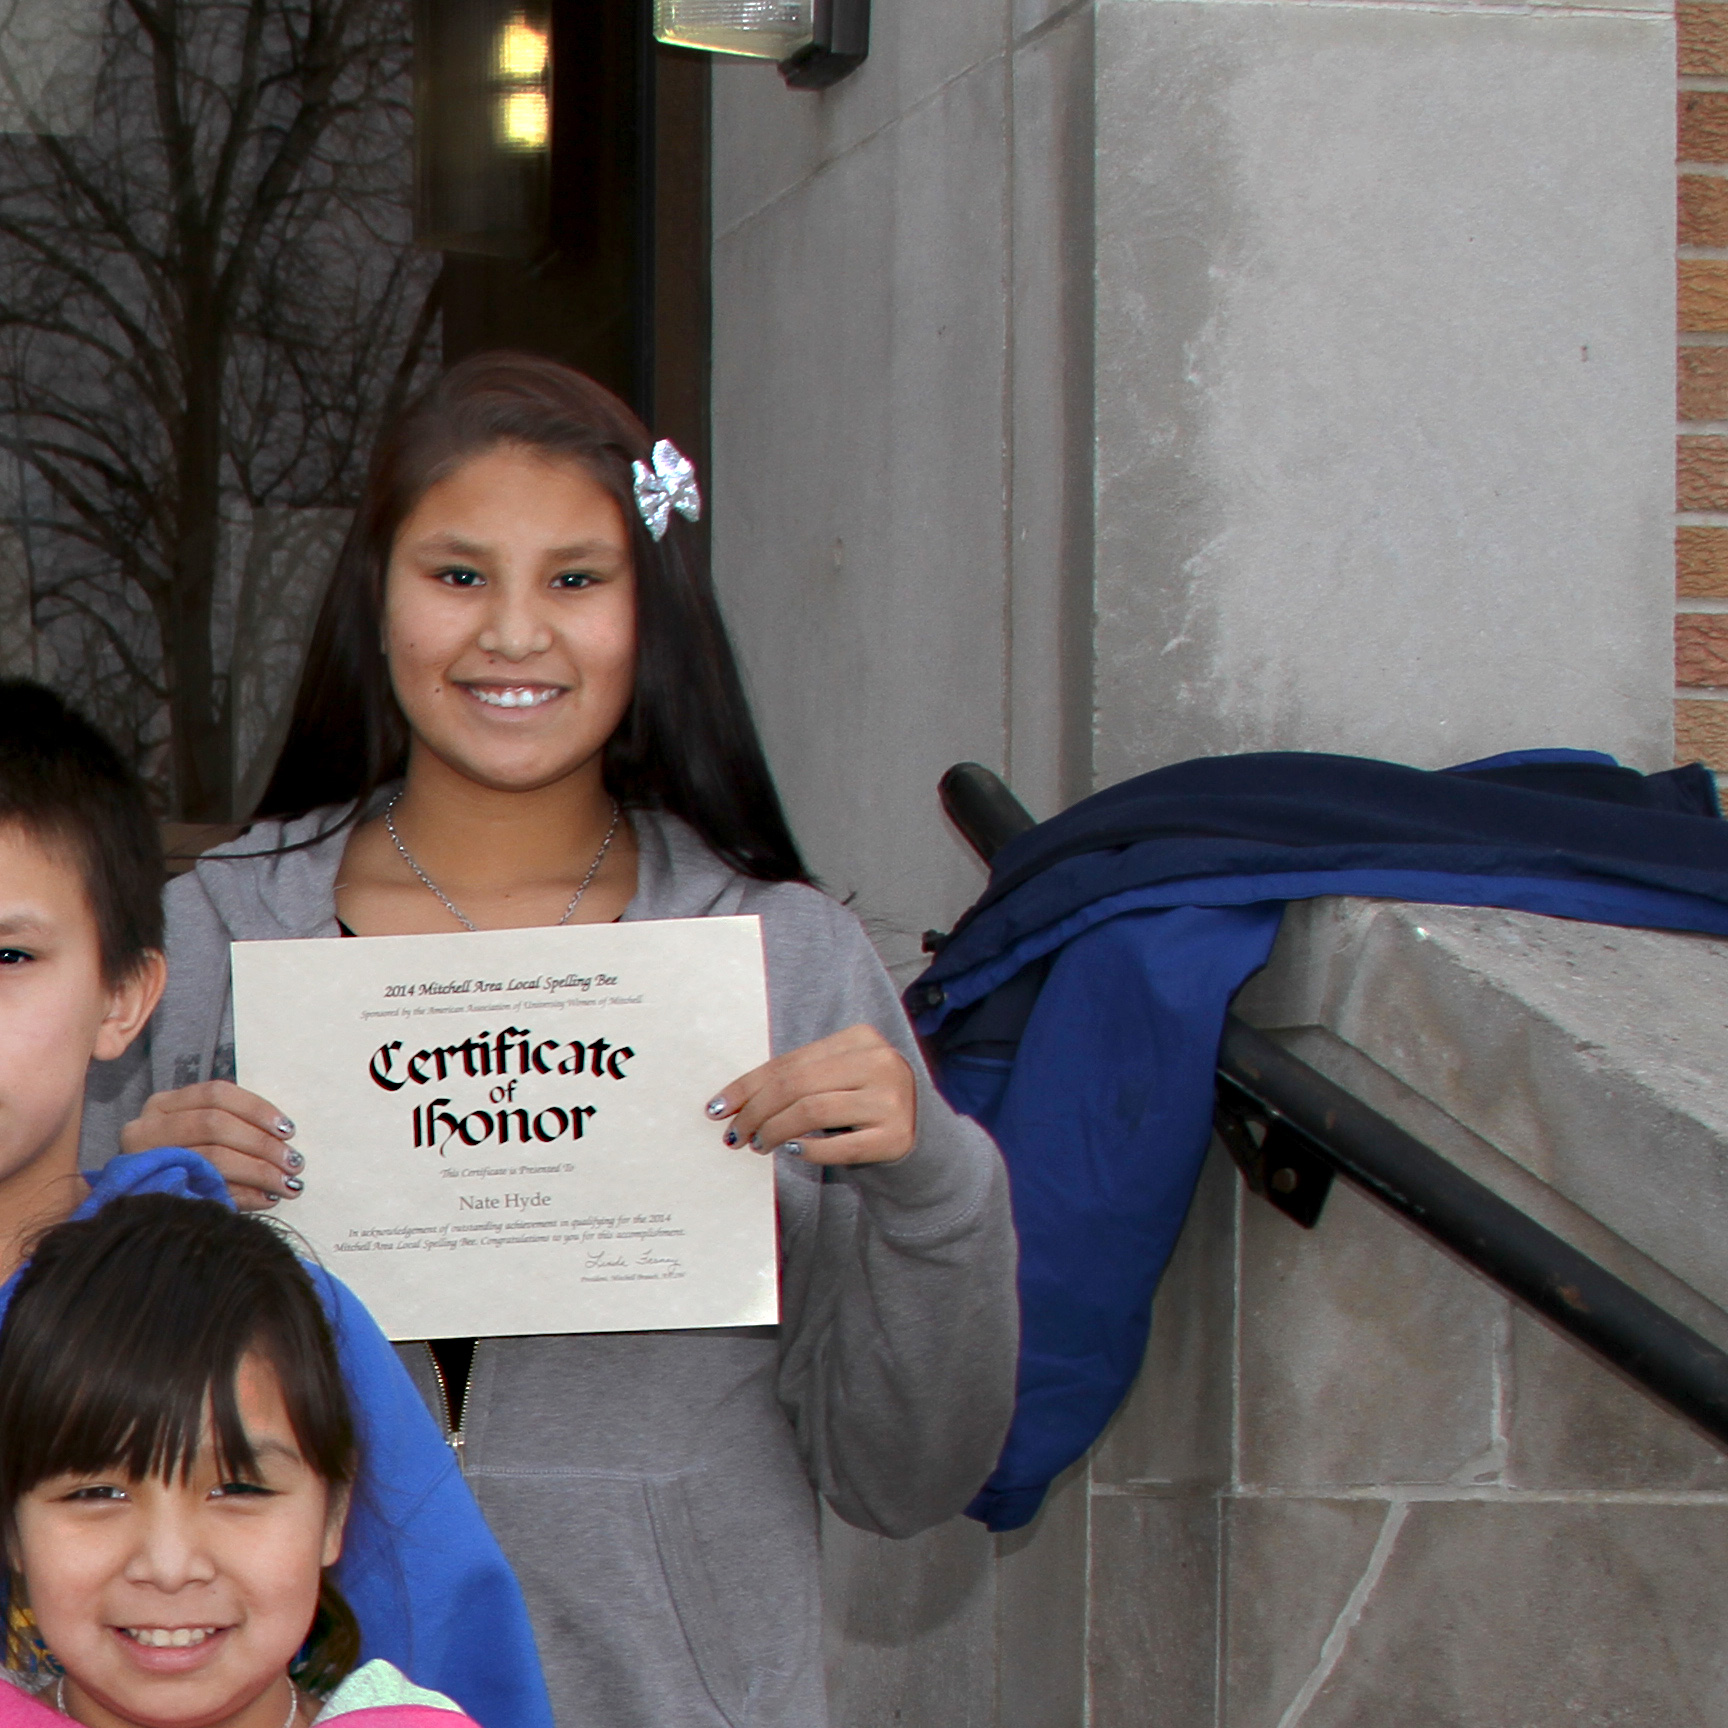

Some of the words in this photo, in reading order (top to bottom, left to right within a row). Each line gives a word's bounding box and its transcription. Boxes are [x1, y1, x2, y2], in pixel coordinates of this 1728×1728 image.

[384, 985, 415, 997] 2014
[418, 979, 473, 996] Mitchell
[472, 980, 503, 993] Area
[506, 976, 543, 991] Local
[543, 974, 593, 994] Spelling
[594, 974, 618, 986] Bee
[369, 1026, 636, 1093] Certificate
[488, 1079, 519, 1104] of
[412, 1092, 598, 1158] Honor
[459, 1196, 500, 1210] Nate
[505, 1192, 551, 1212] Hyde
